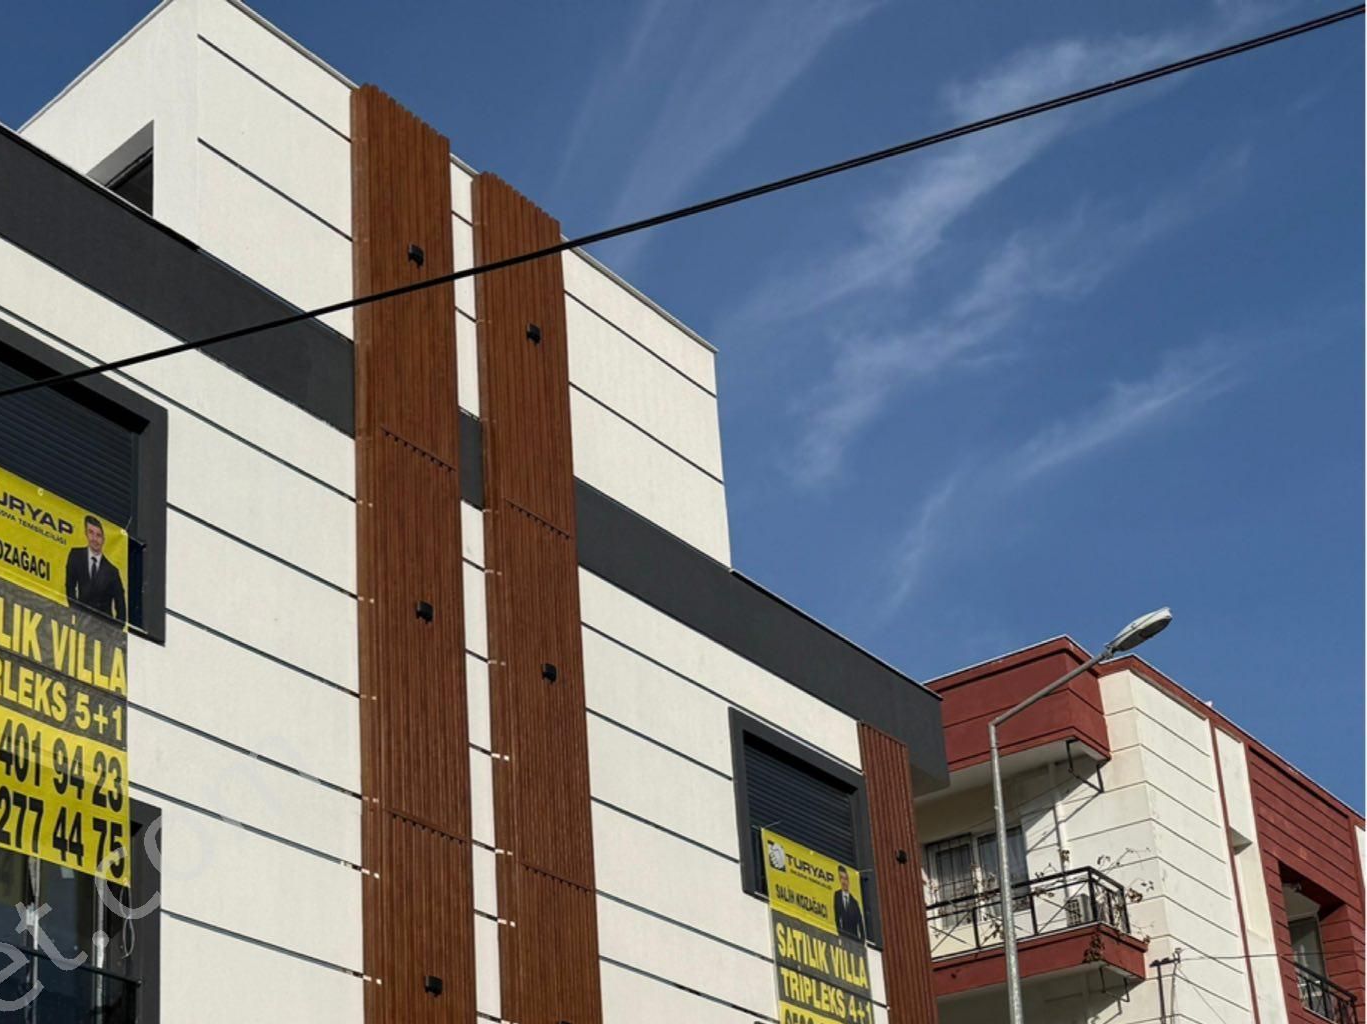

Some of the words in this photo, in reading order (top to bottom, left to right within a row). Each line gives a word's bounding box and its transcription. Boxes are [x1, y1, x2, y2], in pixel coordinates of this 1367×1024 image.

[51, 614, 128, 697] VİLLA
[75, 691, 122, 741] 5+1
[52, 737, 85, 801] 94
[92, 750, 123, 813] 23
[52, 806, 84, 867] 44
[92, 816, 125, 879] 75
[785, 853, 834, 882] TURYAP
[776, 921, 830, 975] SATILIK
[829, 938, 869, 989] VİLLA
[780, 964, 846, 1019] TRİPLEKS
